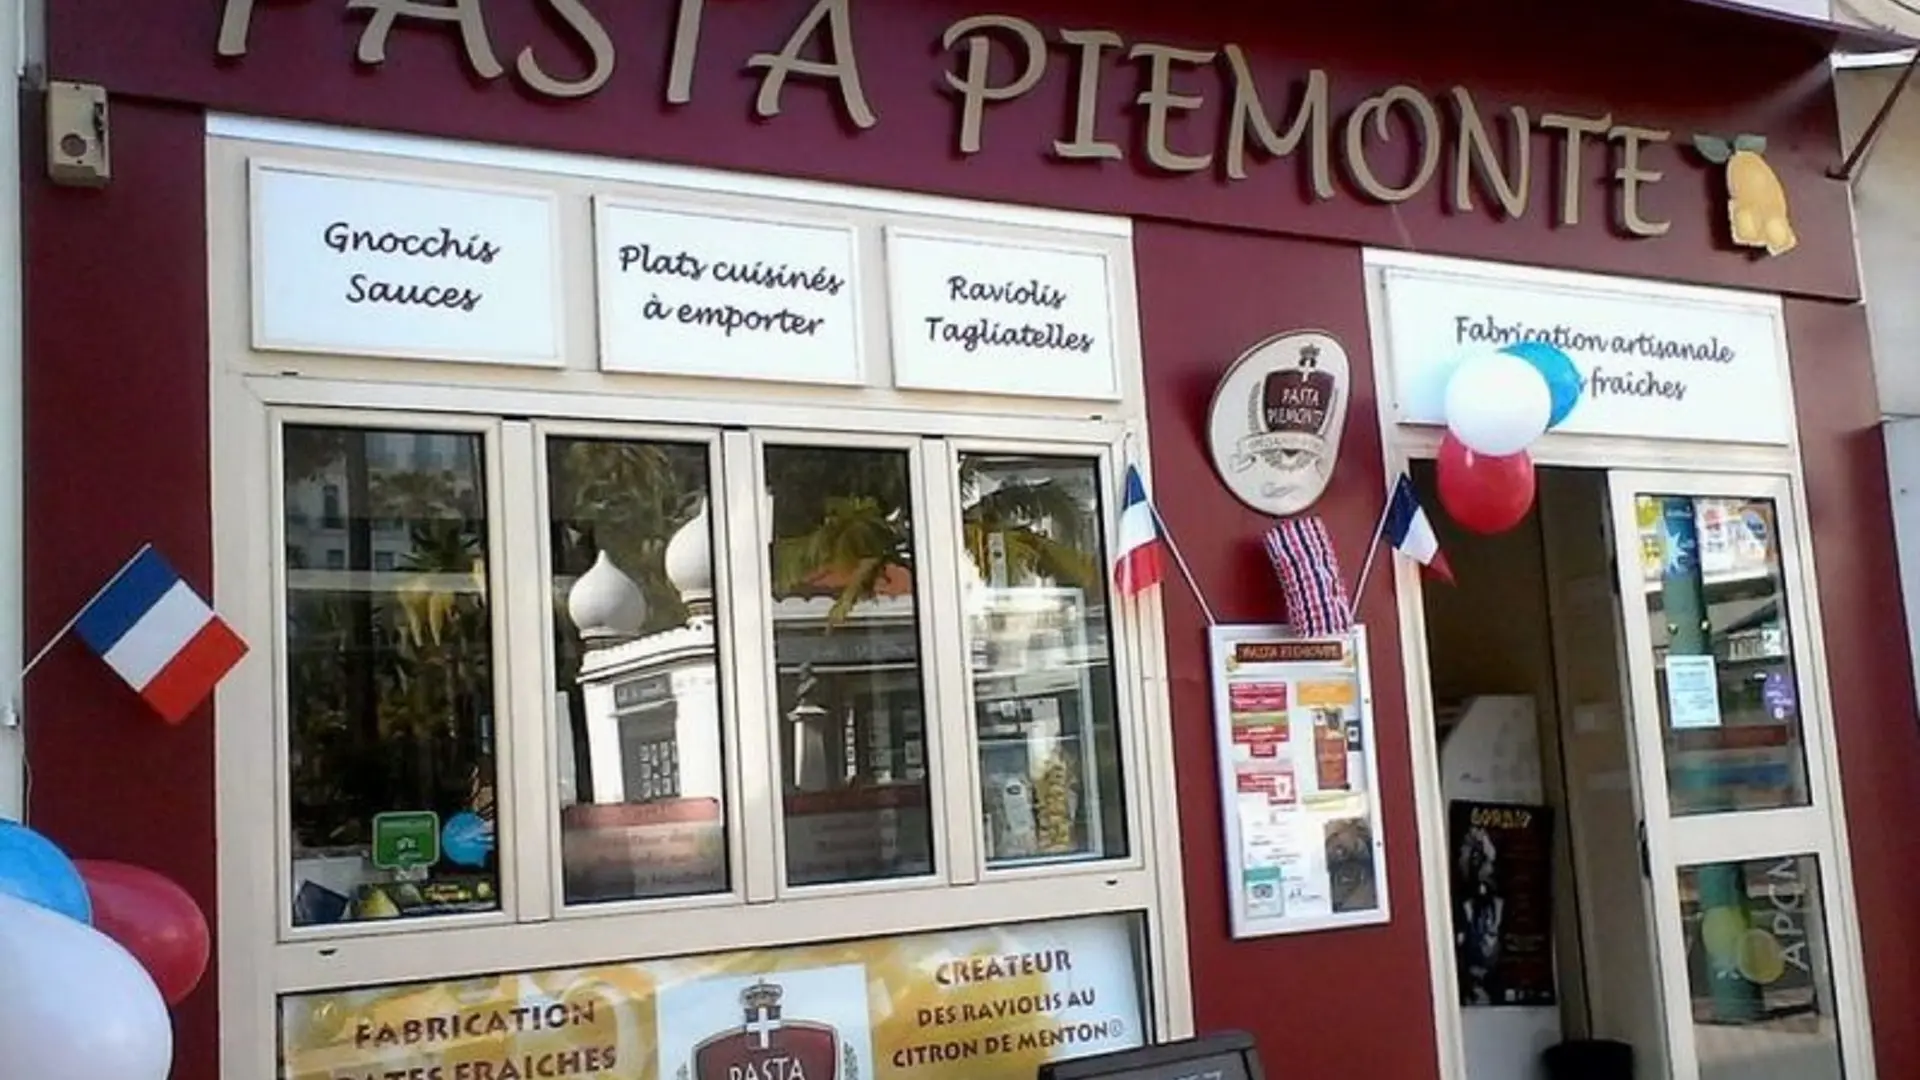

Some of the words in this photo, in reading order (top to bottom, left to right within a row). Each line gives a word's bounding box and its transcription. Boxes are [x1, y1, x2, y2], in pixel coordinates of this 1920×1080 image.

[943, 15, 1670, 236] PIEMONTE
[324, 222, 500, 264] Gnocchis
[619, 244, 707, 281] Plats
[712, 261, 845, 295] cuisinés
[345, 273, 483, 312] Sauces
[948, 275, 1066, 309] Raviolis
[643, 292, 673, 320] à
[677, 303, 824, 337] emporter
[925, 316, 1094, 353] Tagliatelles
[1455, 314, 1608, 353] Fabrication
[1611, 335, 1736, 364] artisanale
[1281, 388, 1319, 406] PASTA
[936, 950, 1072, 985] CREATEUR
[355, 1000, 595, 1049] FABRICATION
[917, 1002, 959, 1027] DES
[963, 994, 1061, 1023] RAVIOLIS
[1067, 987, 1096, 1009] AU
[454, 1045, 616, 1080] FRAICHES
[892, 1042, 978, 1068] CITRON
[984, 1033, 1013, 1055] DE
